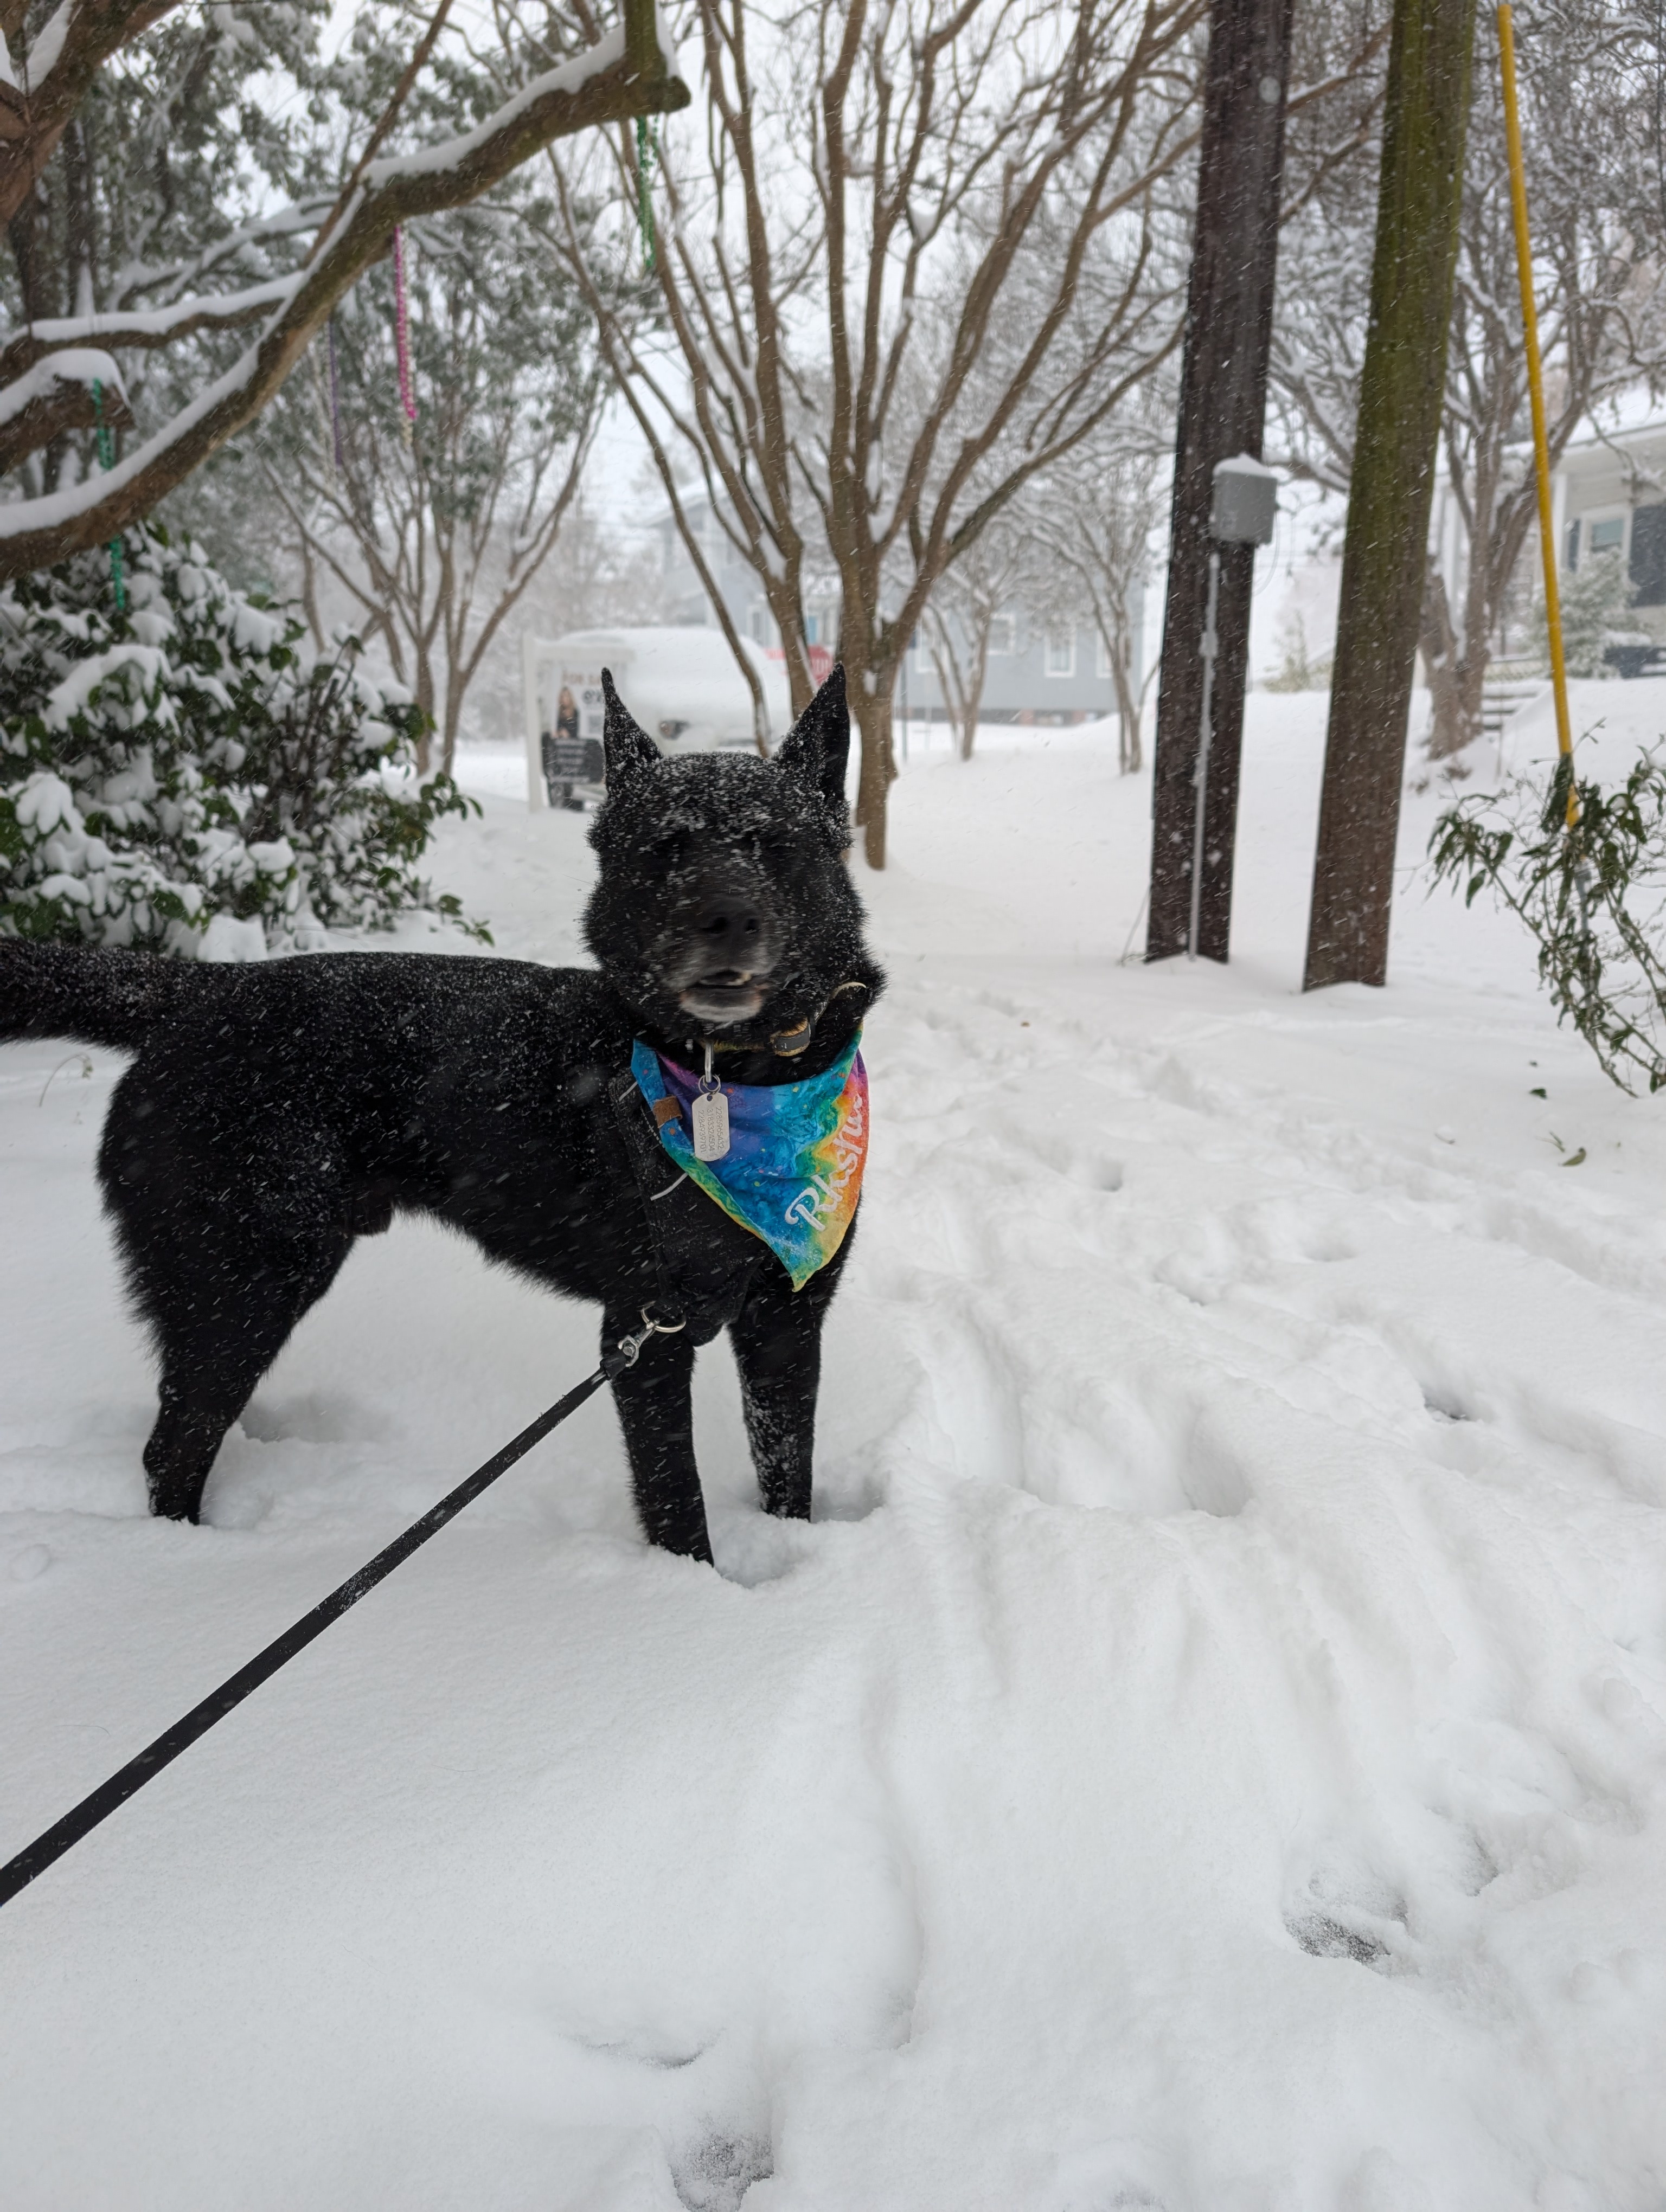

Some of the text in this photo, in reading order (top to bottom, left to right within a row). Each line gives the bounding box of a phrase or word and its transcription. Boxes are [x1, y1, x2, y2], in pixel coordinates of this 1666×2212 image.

[698, 1110, 707, 1153] 2284939701
[707, 1108, 715, 1152] 3183324504
[716, 1106, 724, 1149] 2285965432
